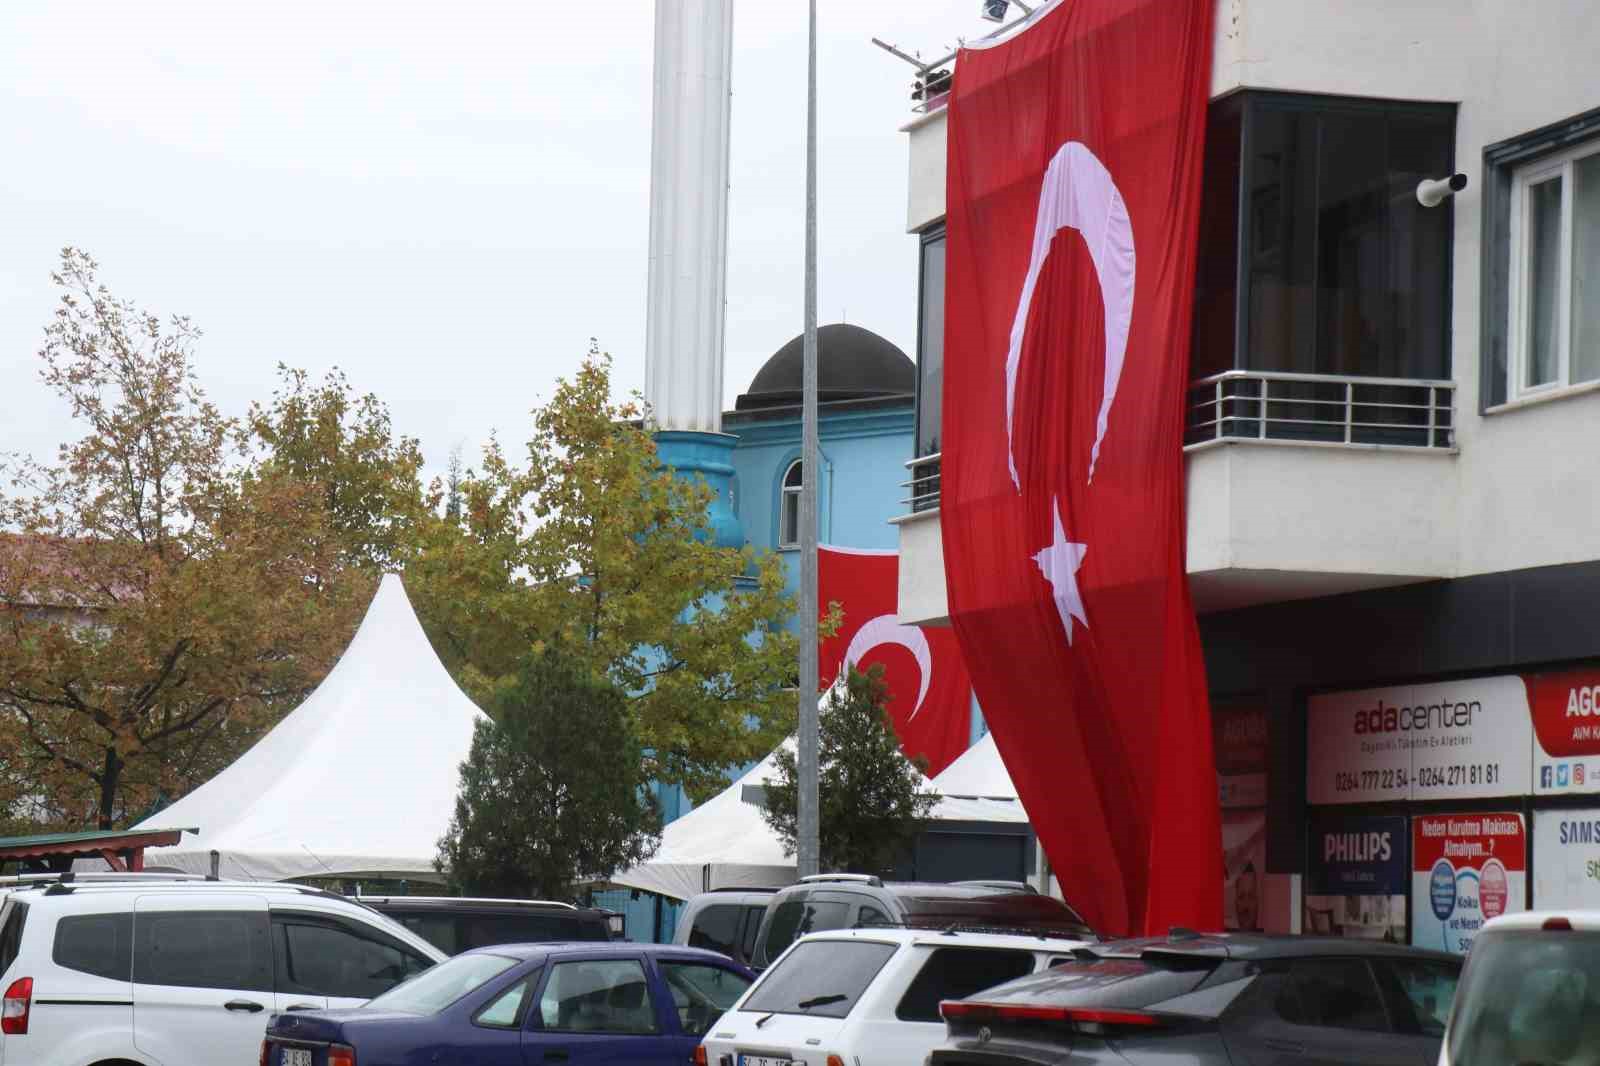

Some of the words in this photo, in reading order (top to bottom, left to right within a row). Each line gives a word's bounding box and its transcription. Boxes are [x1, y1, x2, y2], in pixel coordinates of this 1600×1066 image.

[1354, 698, 1482, 734] adacenter
[1336, 772, 1359, 792] 0264
[1361, 770, 1380, 790] 777
[1381, 769, 1395, 789] 22
[1396, 769, 1408, 788] 54
[1419, 768, 1445, 787] 0264
[1447, 766, 1466, 786] 271
[1470, 764, 1482, 785] 81
[1486, 763, 1499, 784] 81
[1422, 820, 1446, 836] Neden
[1325, 832, 1392, 861] PHILIPS
[1458, 896, 1478, 909] Koku
[1450, 920, 1459, 929] ve
